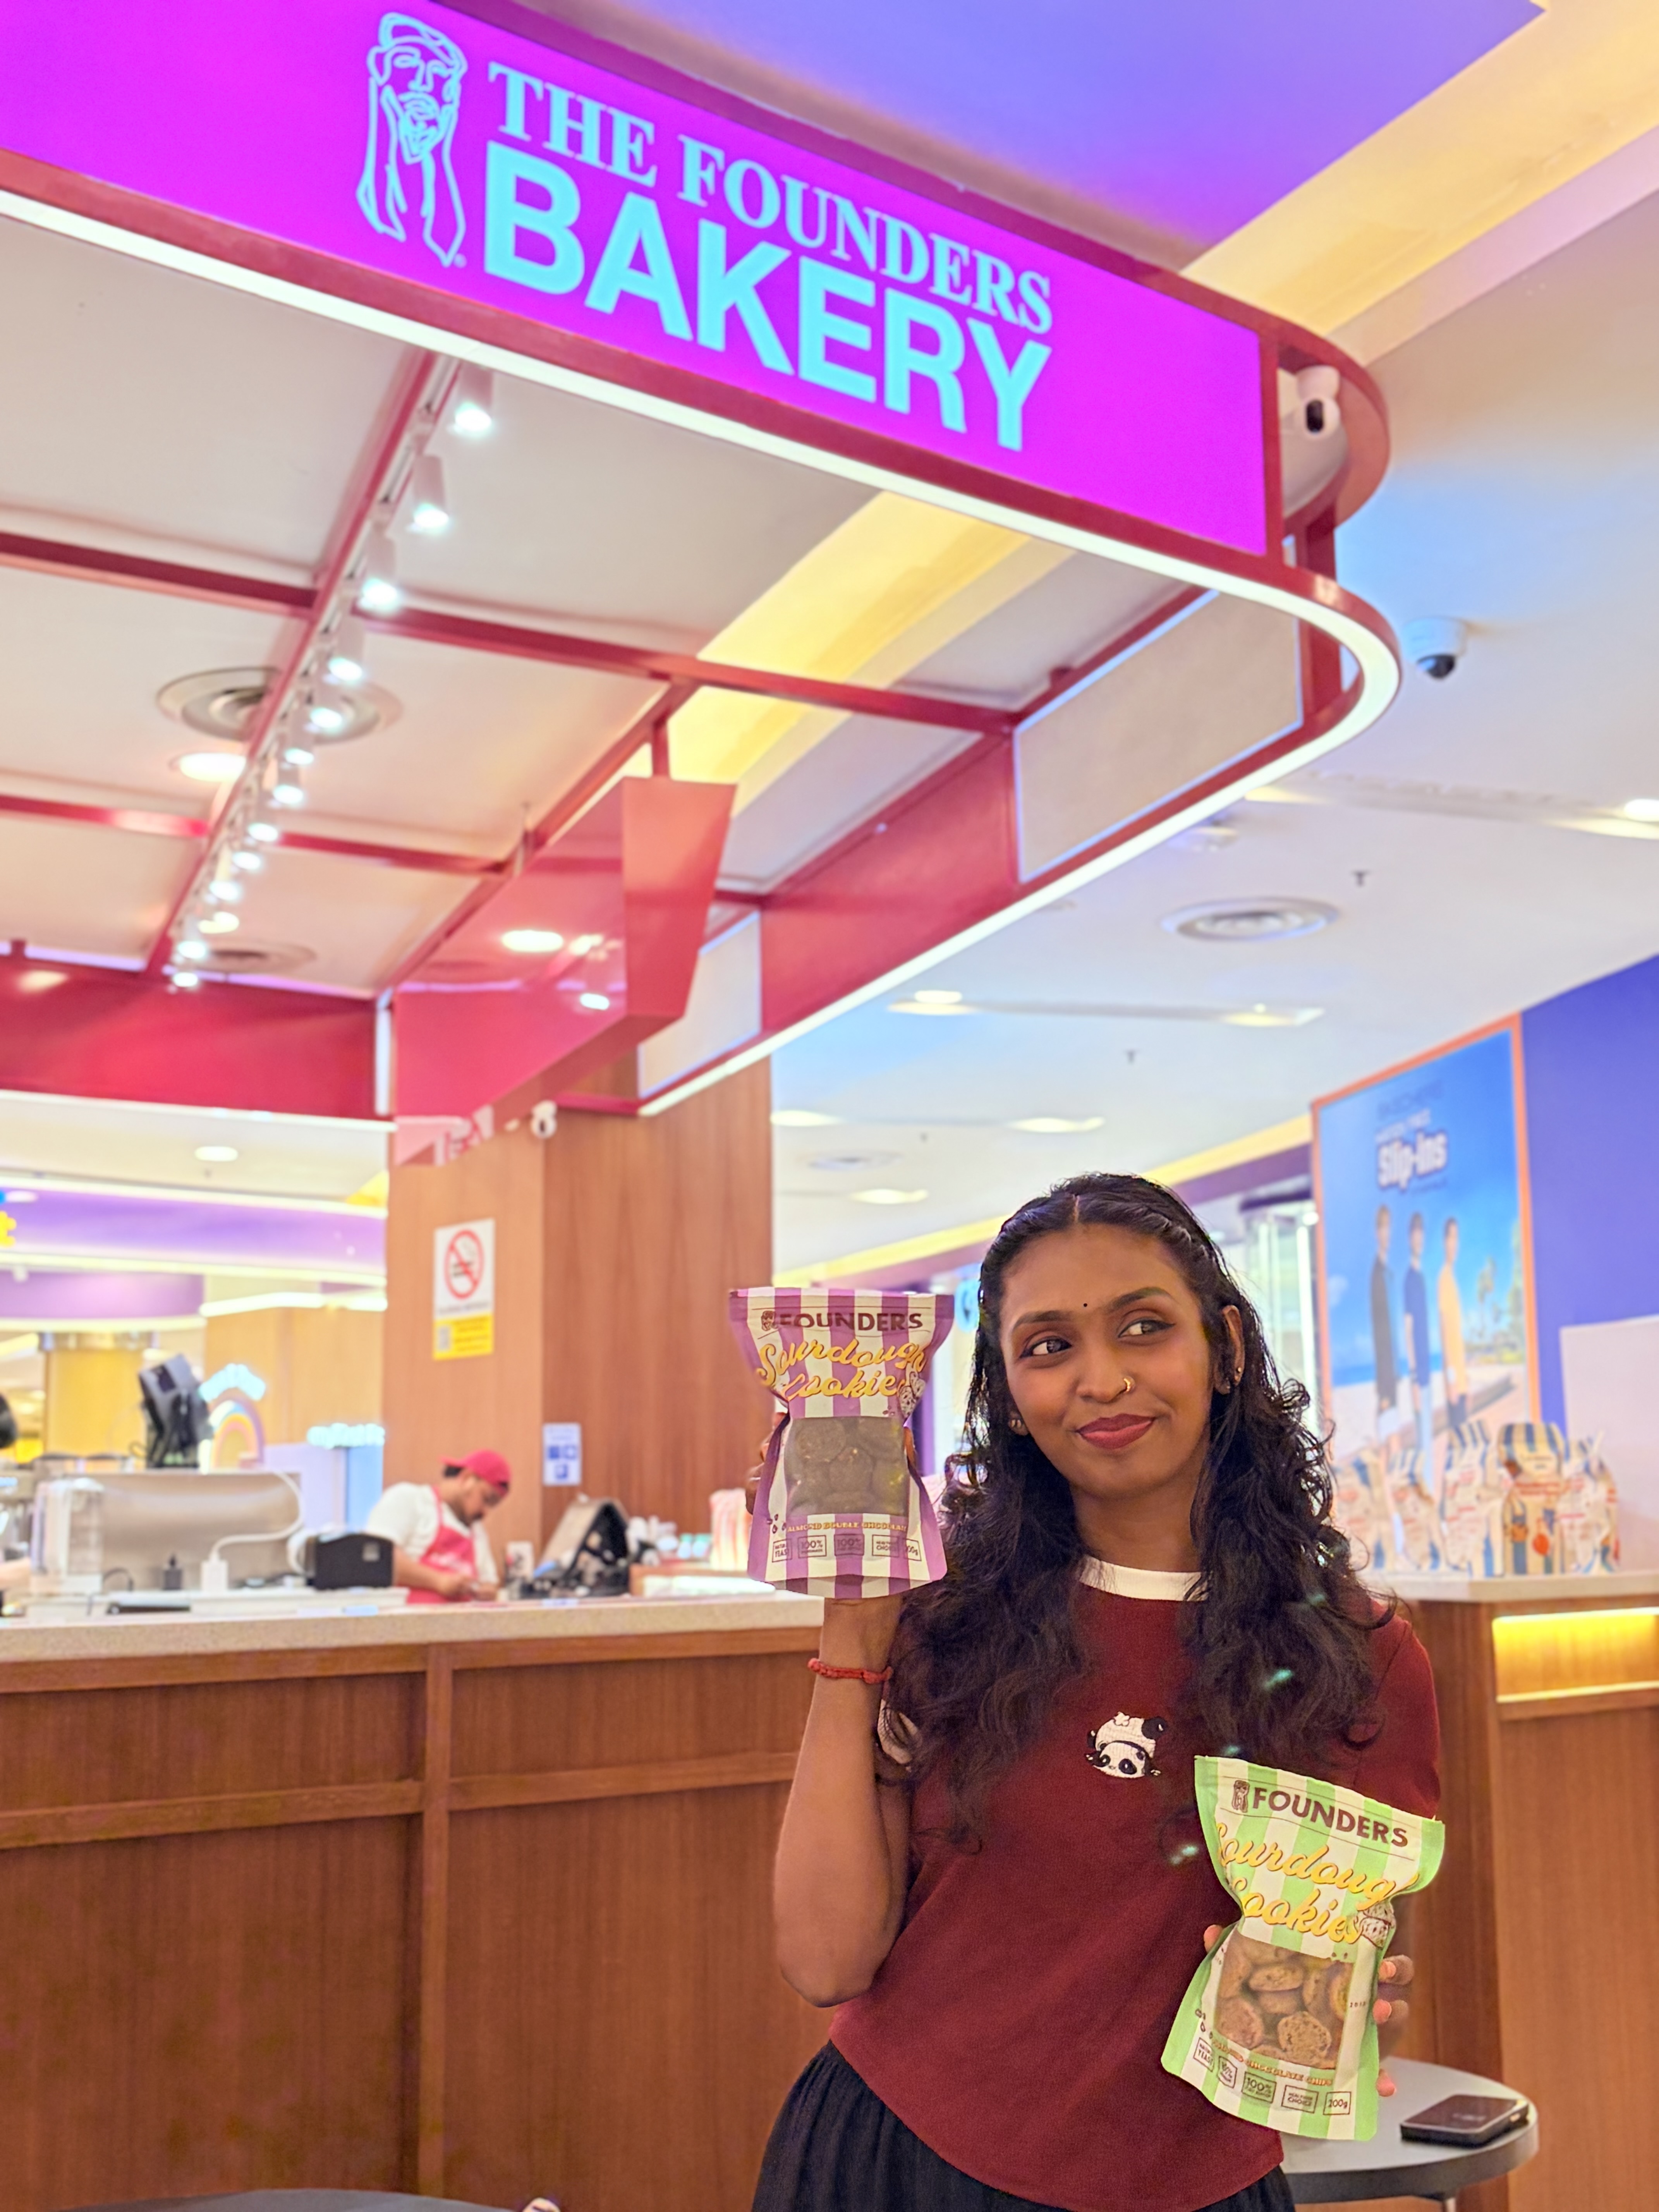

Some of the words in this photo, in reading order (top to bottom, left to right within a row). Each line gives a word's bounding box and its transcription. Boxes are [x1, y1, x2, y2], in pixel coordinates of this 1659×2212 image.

[488, 62, 658, 187] THE
[677, 134, 1052, 334] FOUNDERS
[484, 140, 1052, 452] BAKERY
[779, 1312, 923, 1331] FOUNDERS
[756, 1339, 926, 1387] Sourdough
[1252, 1787, 1408, 1848] FOUNDERS
[1246, 2077, 1272, 2094] 100%
[1329, 2099, 1348, 2109] 200g
